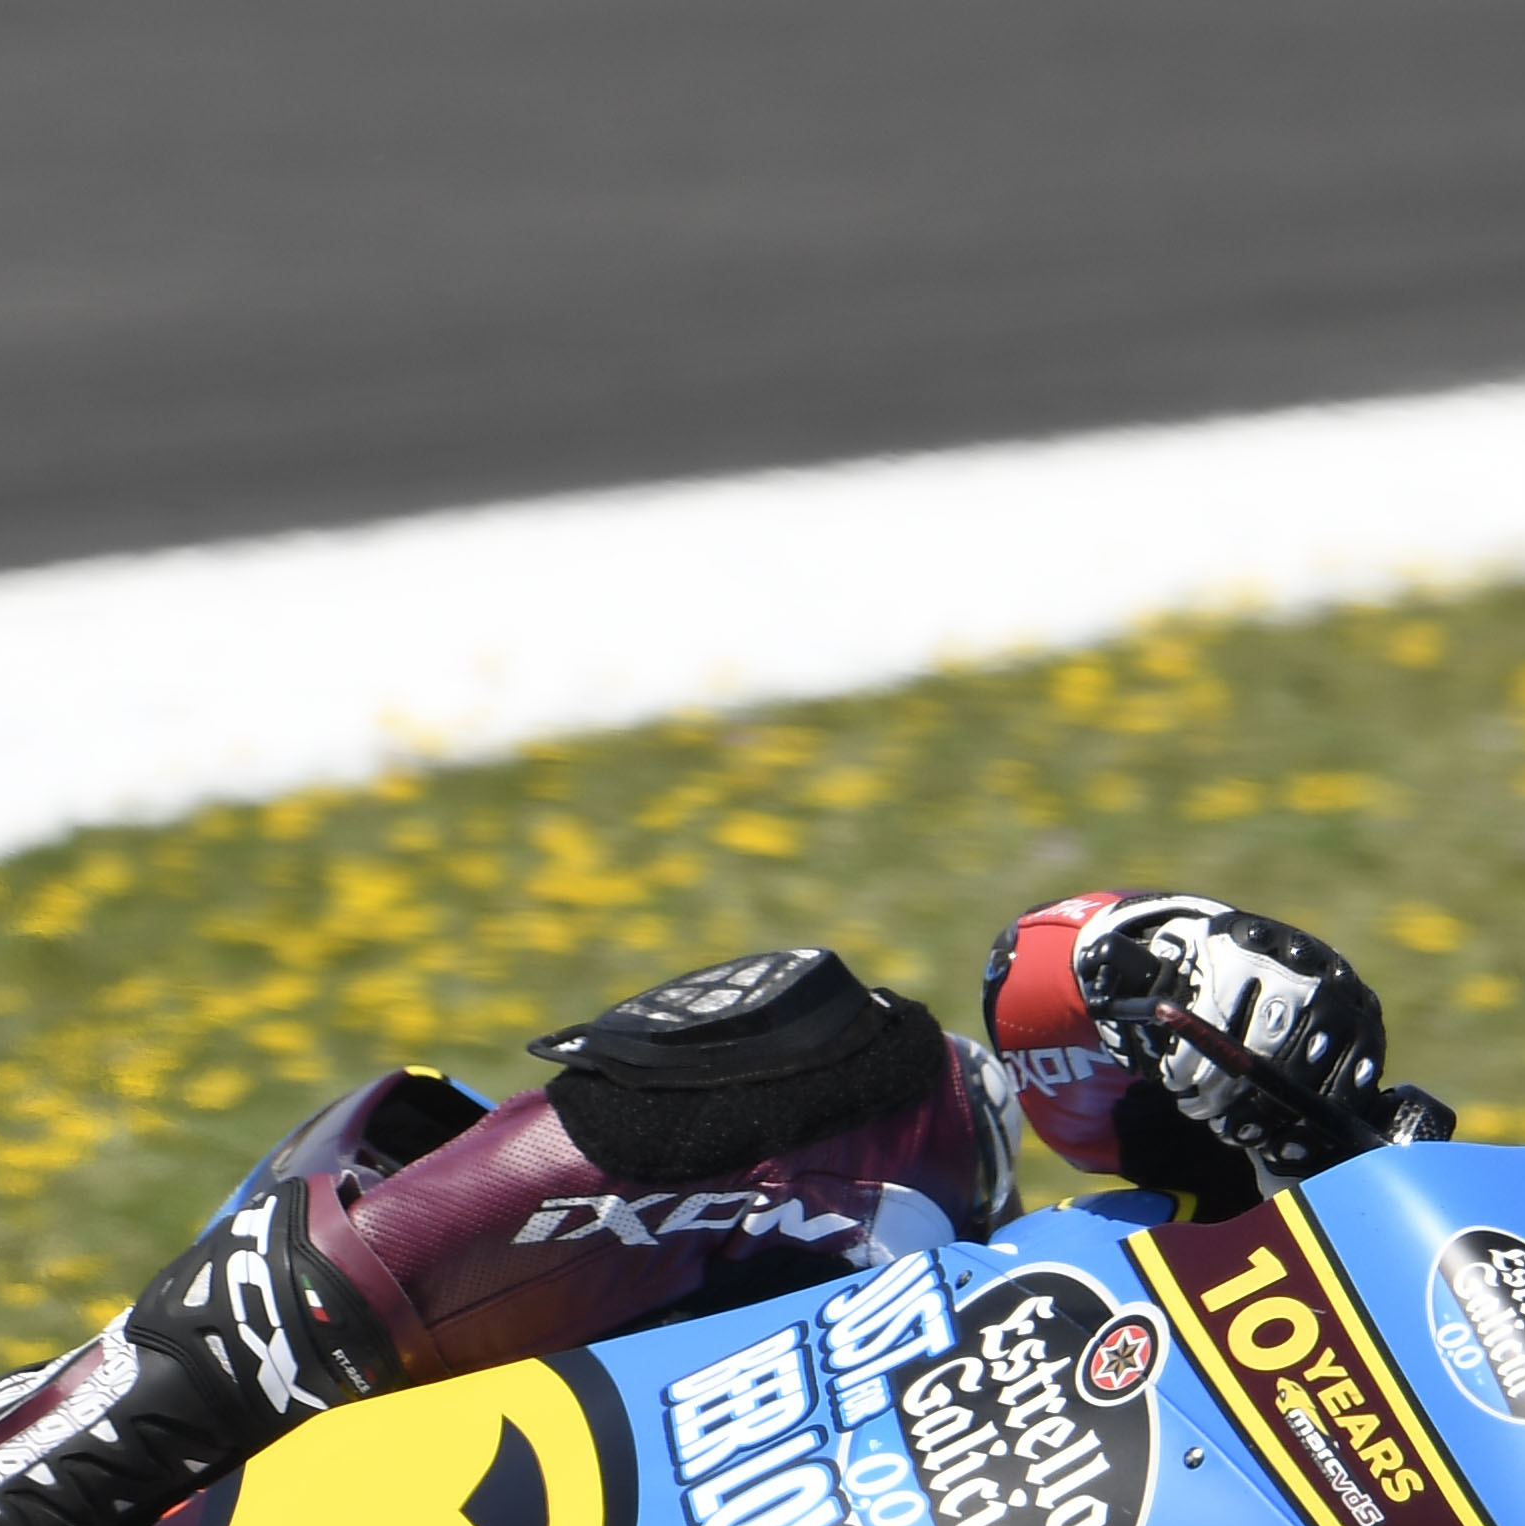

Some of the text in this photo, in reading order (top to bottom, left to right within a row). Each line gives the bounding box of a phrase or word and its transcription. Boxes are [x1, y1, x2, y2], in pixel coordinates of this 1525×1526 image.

[227, 1195, 330, 1415] TCX
[822, 1249, 954, 1391] JUST
[1201, 1246, 1425, 1503] 10 YEARS
[664, 1324, 819, 1484] BEER
